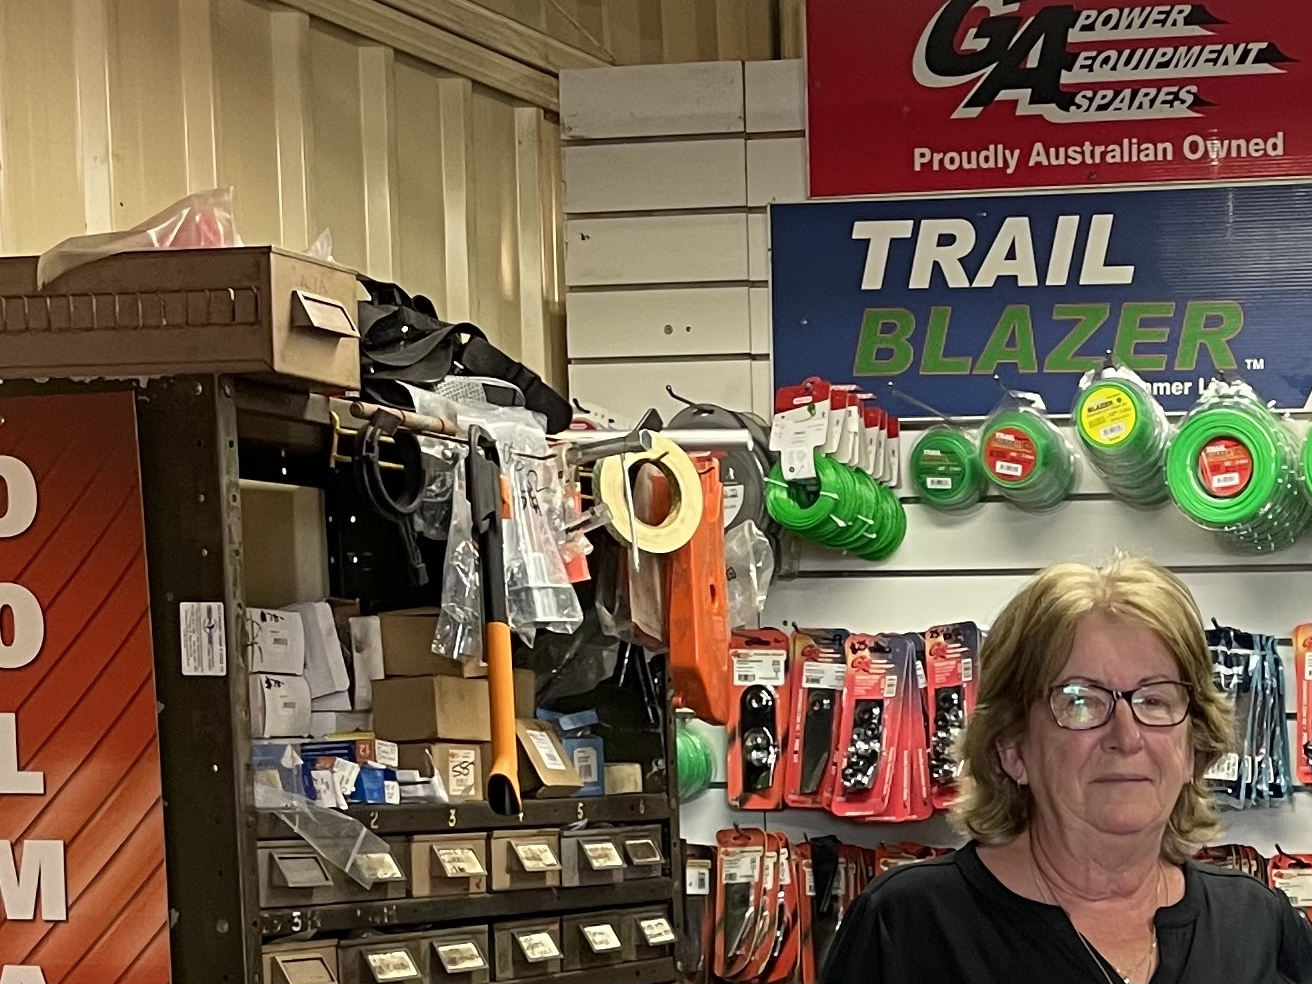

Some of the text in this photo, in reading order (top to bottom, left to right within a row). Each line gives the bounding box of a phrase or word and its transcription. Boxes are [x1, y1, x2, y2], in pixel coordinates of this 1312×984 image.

[1075, 4, 1192, 32] POWER
[1075, 42, 1268, 73] EQUIPMENT
[1069, 86, 1197, 113] SPARES
[914, 132, 1284, 174] Proudly Australian Owned
[852, 214, 1134, 290] TRAIL
[853, 301, 1244, 376] BLAZER
